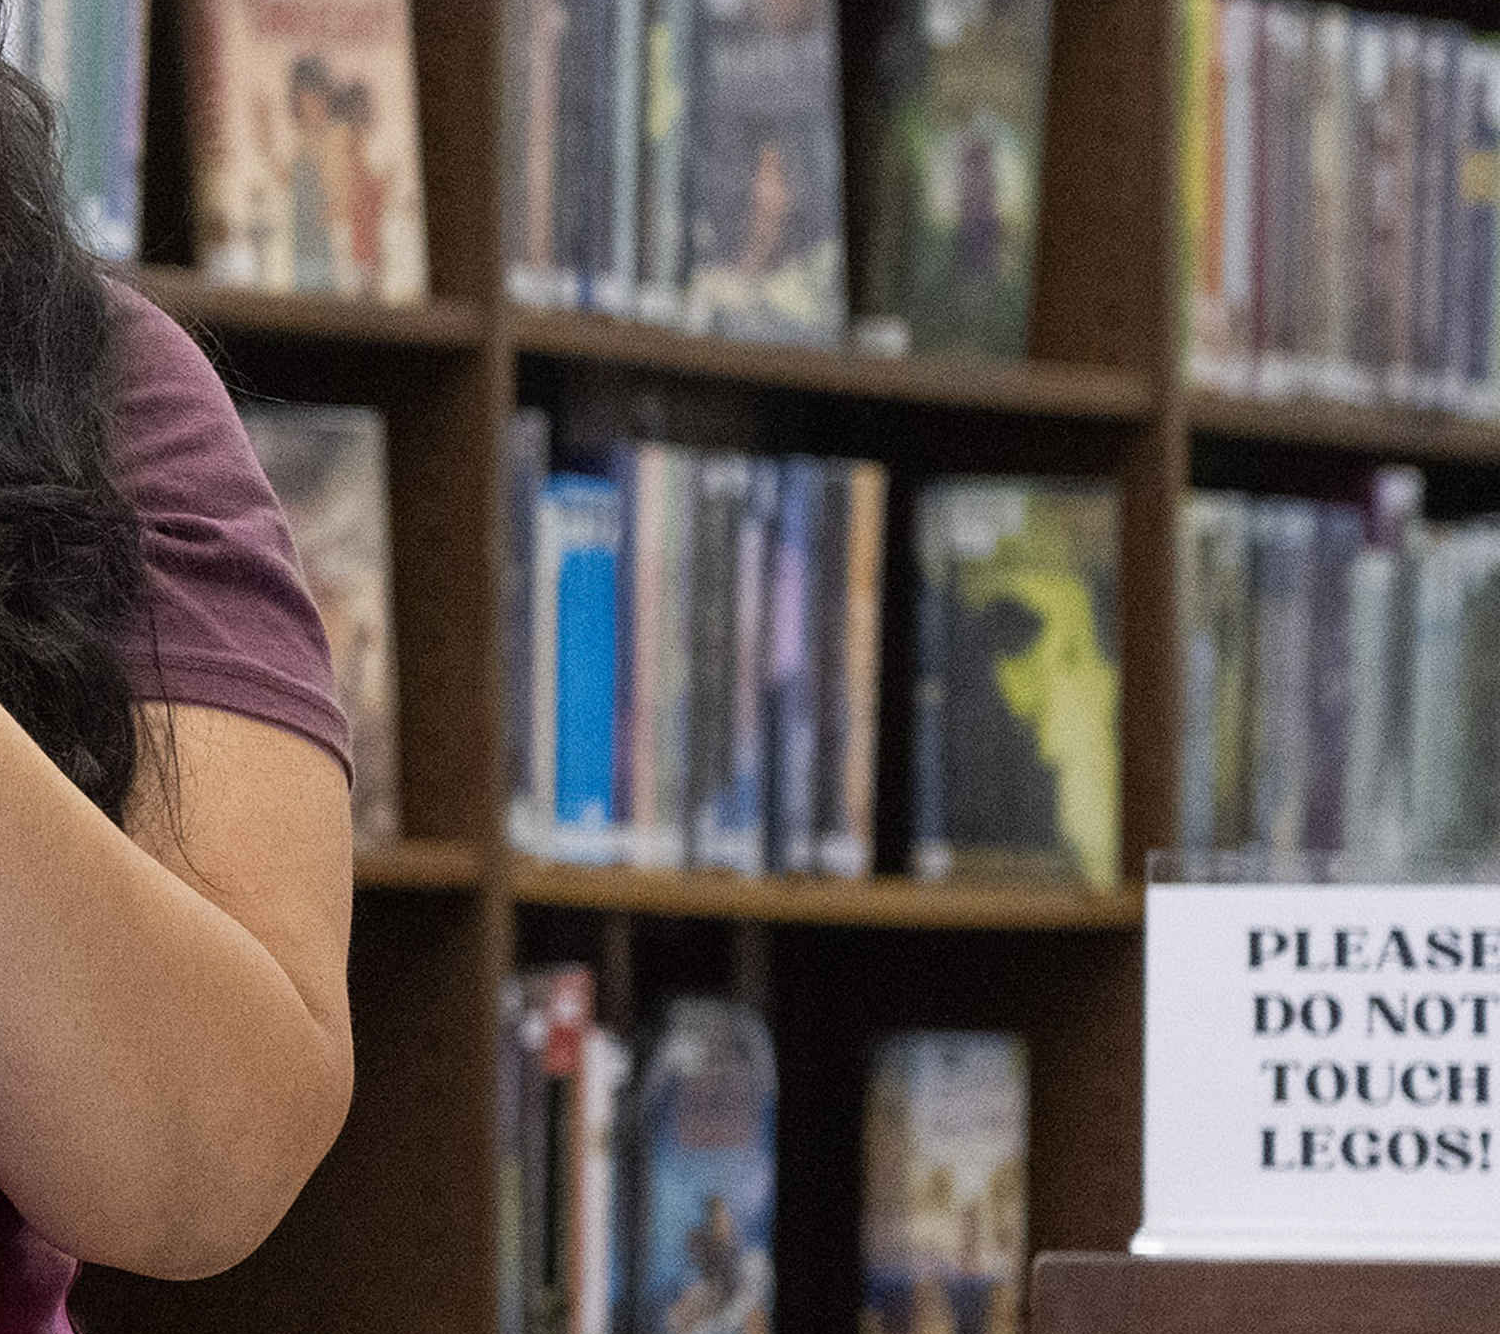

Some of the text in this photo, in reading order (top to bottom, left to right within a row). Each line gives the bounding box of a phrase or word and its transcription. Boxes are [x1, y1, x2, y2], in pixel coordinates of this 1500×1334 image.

[1247, 925, 1500, 971] PLEASE
[1253, 992, 1500, 1037] DO NOT
[1261, 1058, 1491, 1107] TOUCH
[1260, 1126, 1493, 1172] LEGOS!
